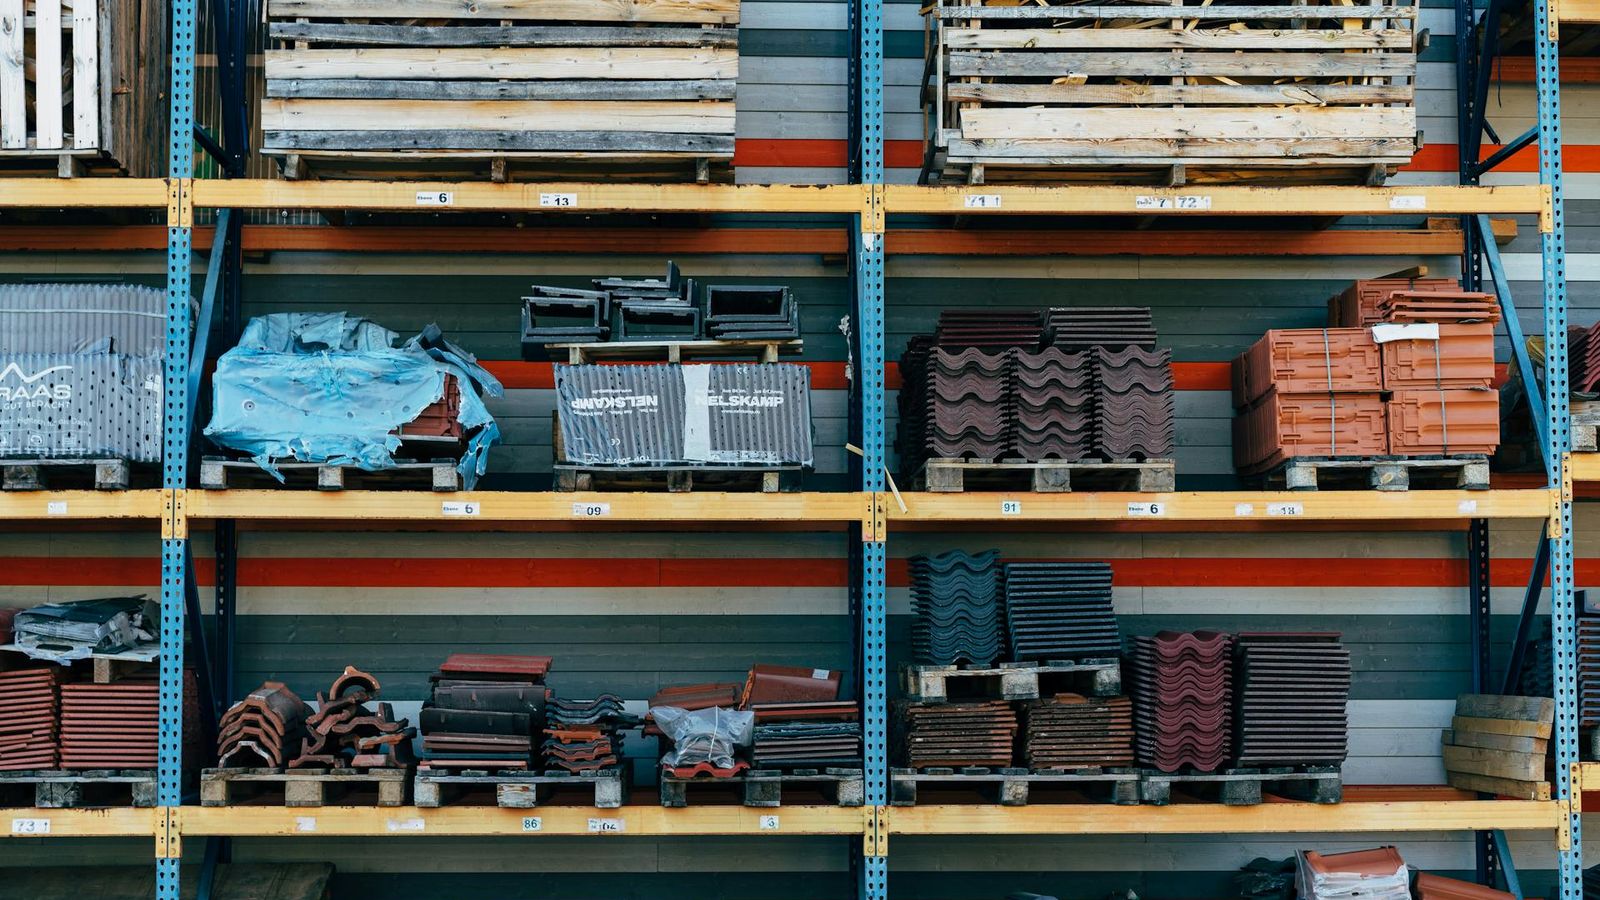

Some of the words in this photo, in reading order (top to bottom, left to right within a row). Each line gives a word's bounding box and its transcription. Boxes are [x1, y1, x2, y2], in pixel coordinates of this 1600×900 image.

[438, 192, 448, 203] 6
[554, 197, 570, 206] 13
[1177, 196, 1198, 208] 72
[3, 401, 23, 410] GUT
[571, 394, 658, 409] NELSKAMP
[464, 504, 474, 515] 6
[586, 506, 602, 516] 09
[1004, 503, 1016, 512] 91
[1150, 504, 1159, 514] 6
[524, 818, 538, 829] 86
